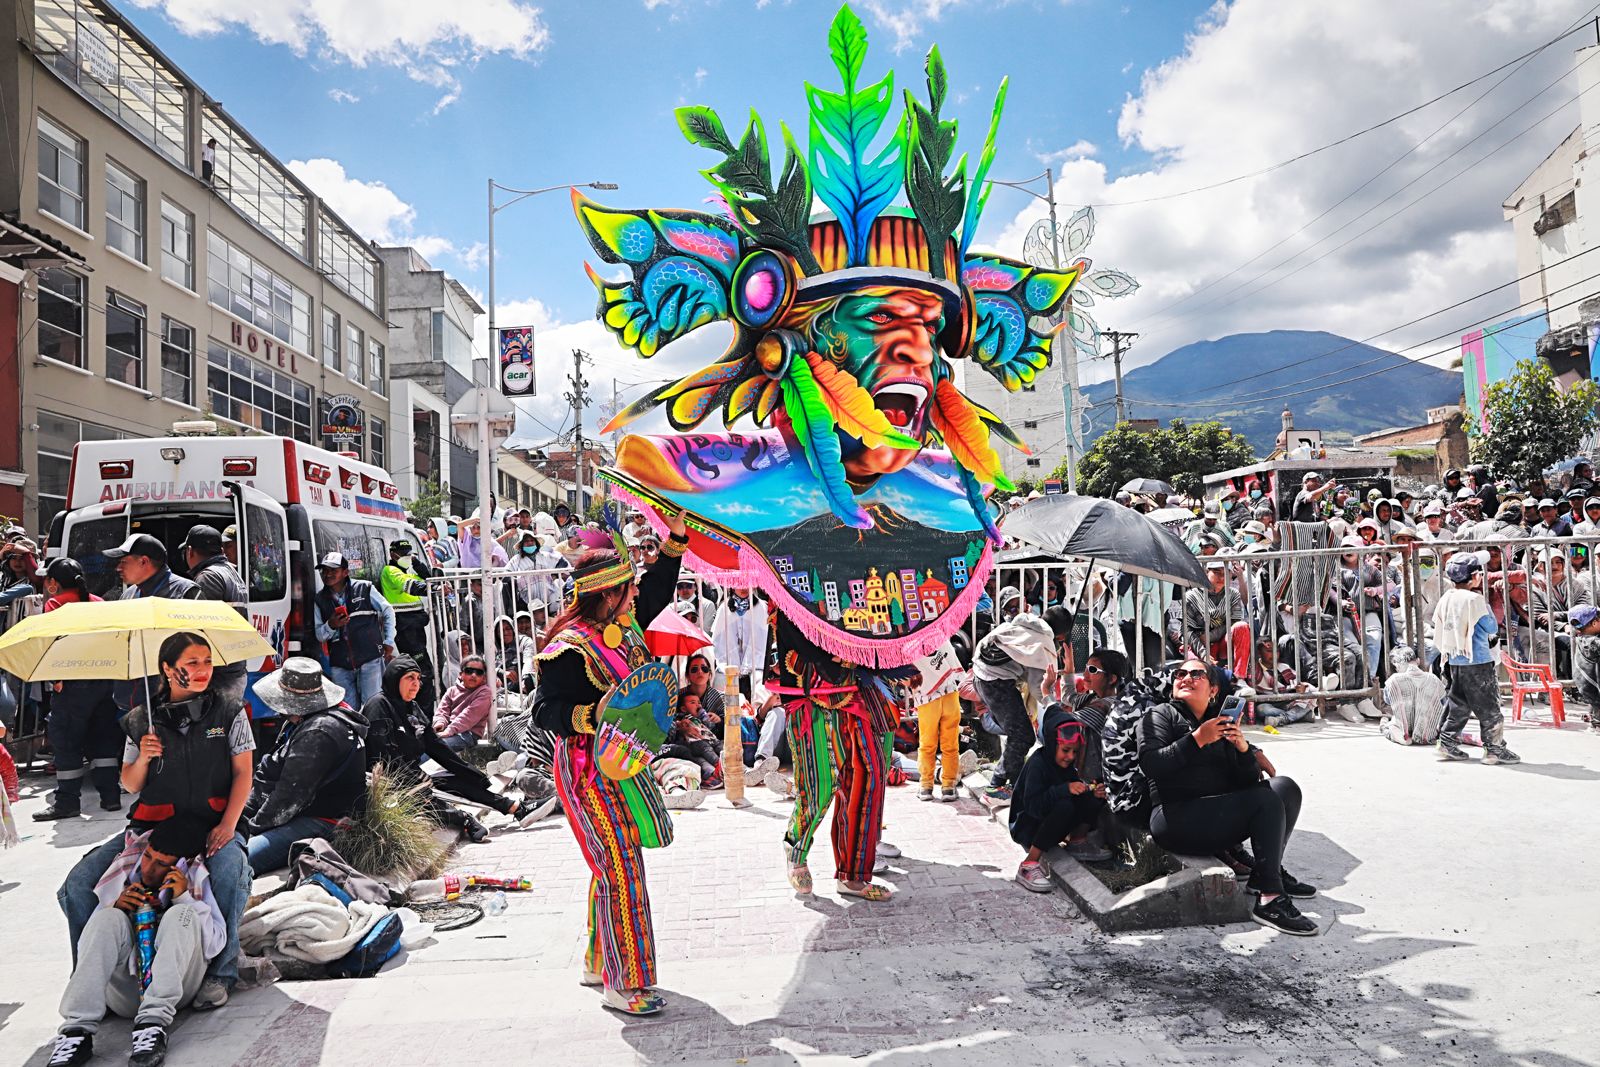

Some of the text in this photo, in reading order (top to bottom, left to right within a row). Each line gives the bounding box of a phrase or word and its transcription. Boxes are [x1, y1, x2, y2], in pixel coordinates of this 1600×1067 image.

[231, 321, 298, 374] HOTEL
[507, 371, 528, 380] acar
[98, 480, 255, 503] AMBULANC
[309, 485, 324, 503] TAM
[342, 498, 351, 510] 08
[252, 614, 270, 634] TAM
[620, 667, 678, 717] VOLCANICOS
